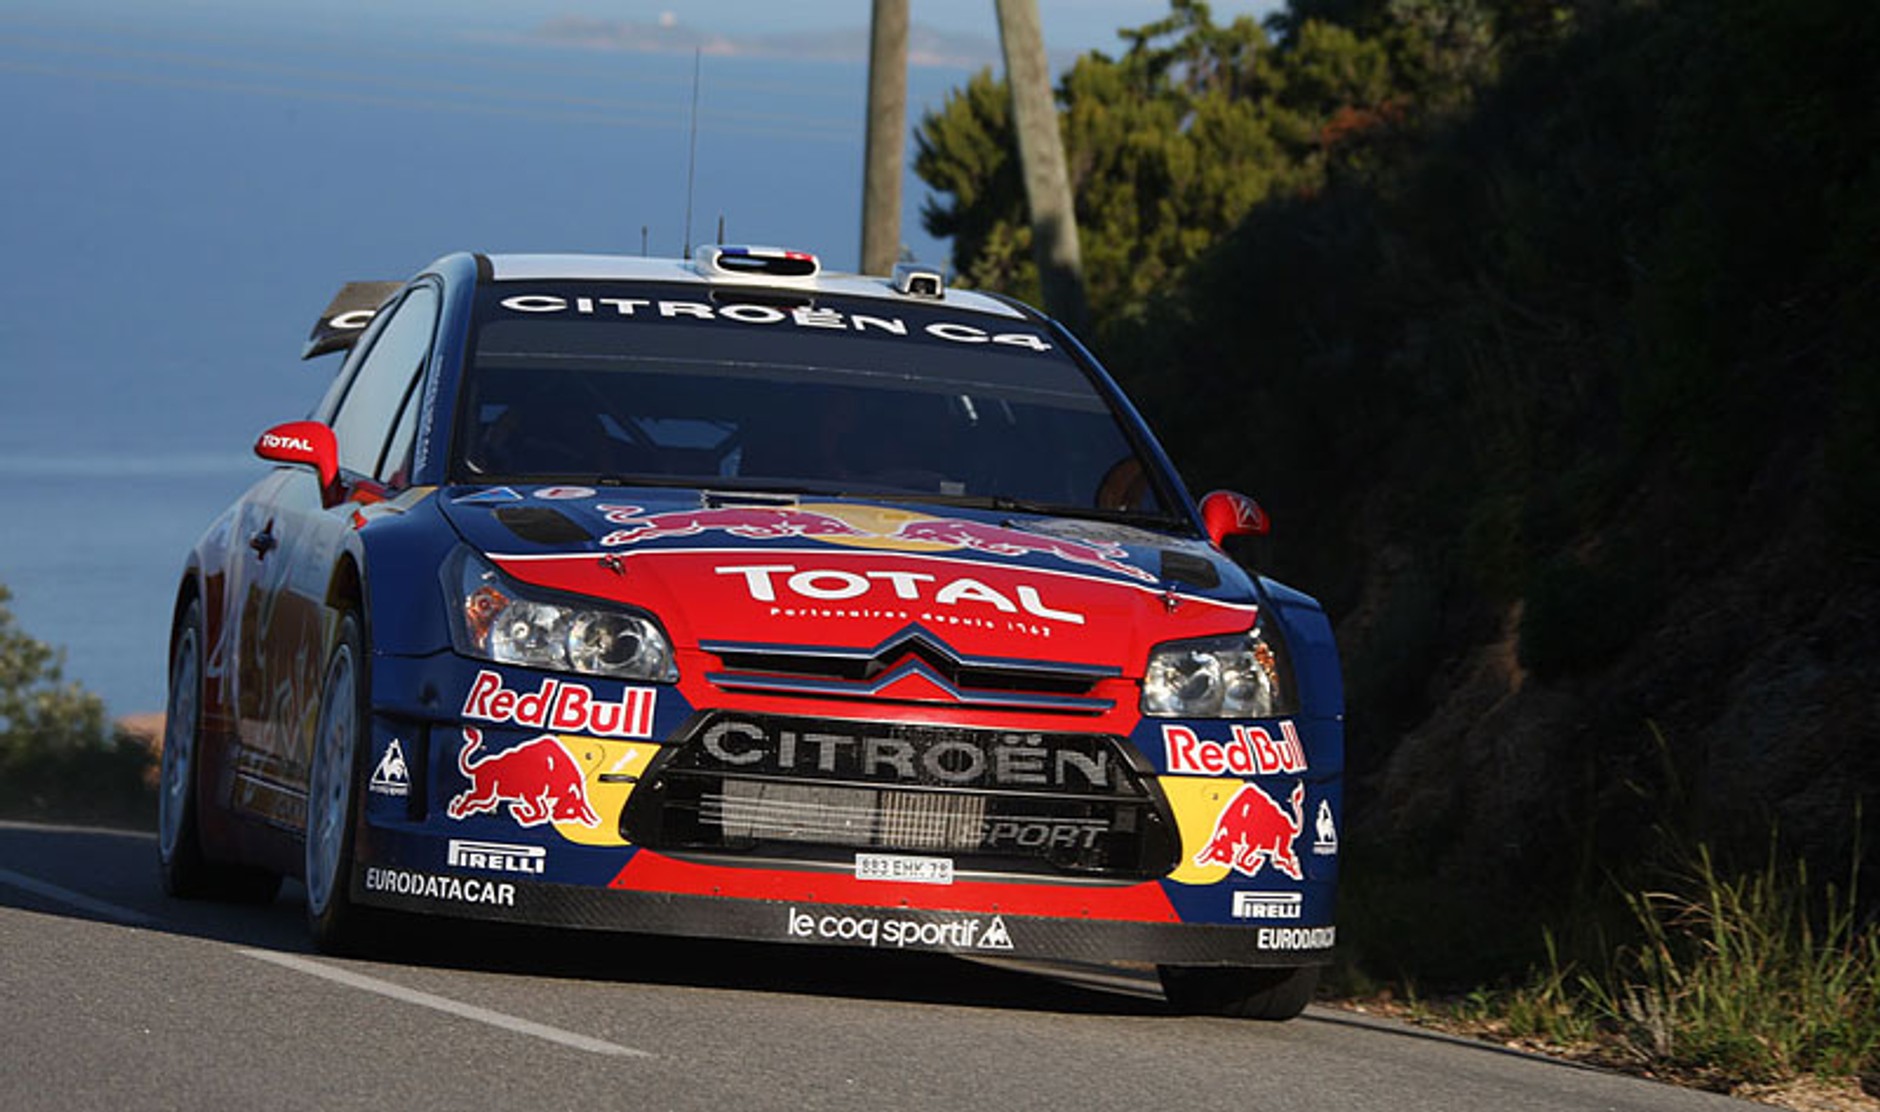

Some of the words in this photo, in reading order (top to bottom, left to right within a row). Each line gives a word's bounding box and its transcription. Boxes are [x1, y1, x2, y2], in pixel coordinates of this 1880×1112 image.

[501, 295, 907, 335] CITROËN
[925, 323, 1052, 351] C4
[263, 434, 314, 452] TOTAL
[715, 564, 1085, 624] TOTAL
[462, 670, 558, 728] Red
[548, 684, 657, 738] Bull
[703, 721, 1109, 787] CITROËN
[1162, 724, 1256, 775] Red
[1247, 720, 1308, 775] Bull
[448, 839, 547, 873] PIRELLI
[366, 868, 516, 906] EURODATACAR
[1232, 891, 1302, 918] PIRELLI
[788, 907, 815, 936] le
[819, 916, 878, 947] coq
[881, 918, 979, 948] sportif
